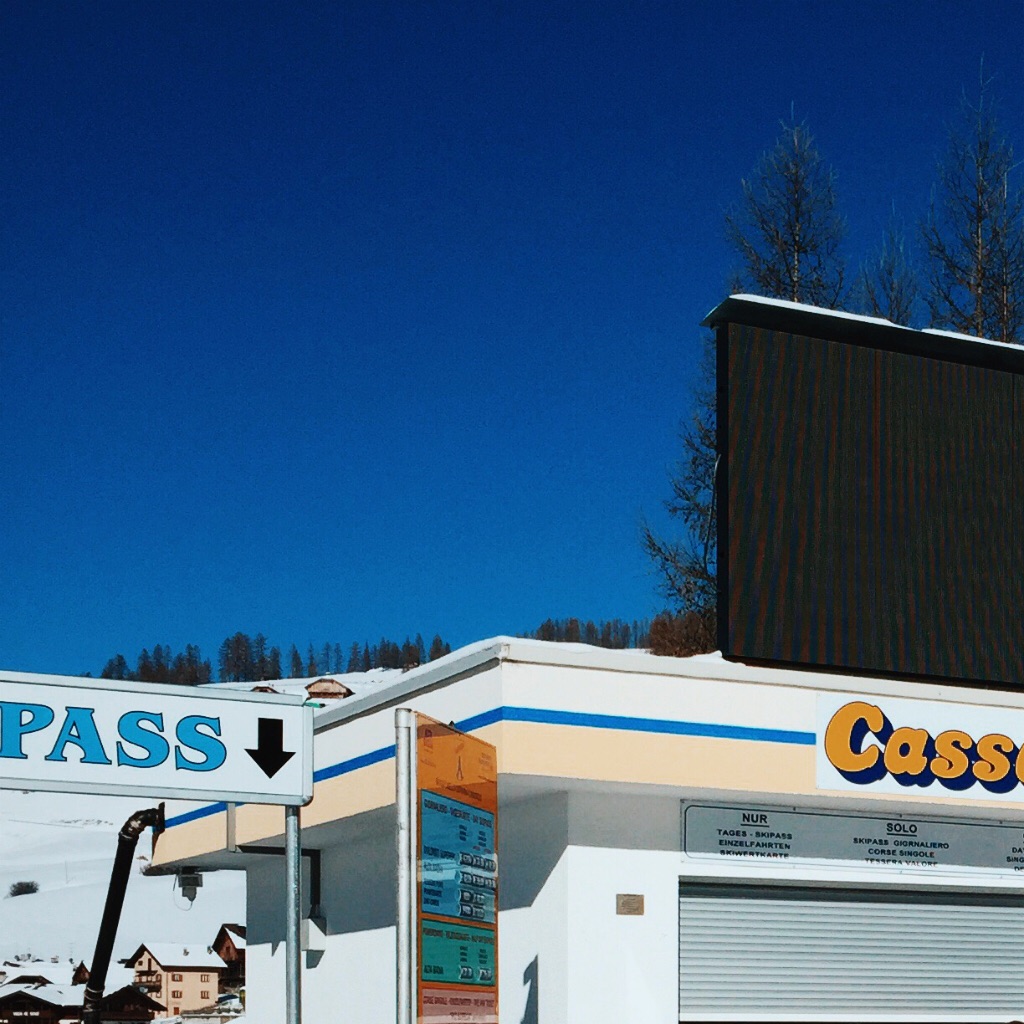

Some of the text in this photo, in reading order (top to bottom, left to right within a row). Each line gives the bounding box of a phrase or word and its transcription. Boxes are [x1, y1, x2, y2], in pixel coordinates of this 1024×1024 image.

[0, 702, 227, 772] PASS
[742, 813, 768, 824] NUR
[886, 822, 917, 834] SOLO
[717, 829, 747, 838] TAGES
[755, 831, 792, 840] SKIPASS
[719, 839, 791, 850] EINZELFAHRTEN
[853, 837, 950, 849] SKIPASS GIORNALIERO
[868, 848, 935, 858] CORSE SINGOLE
